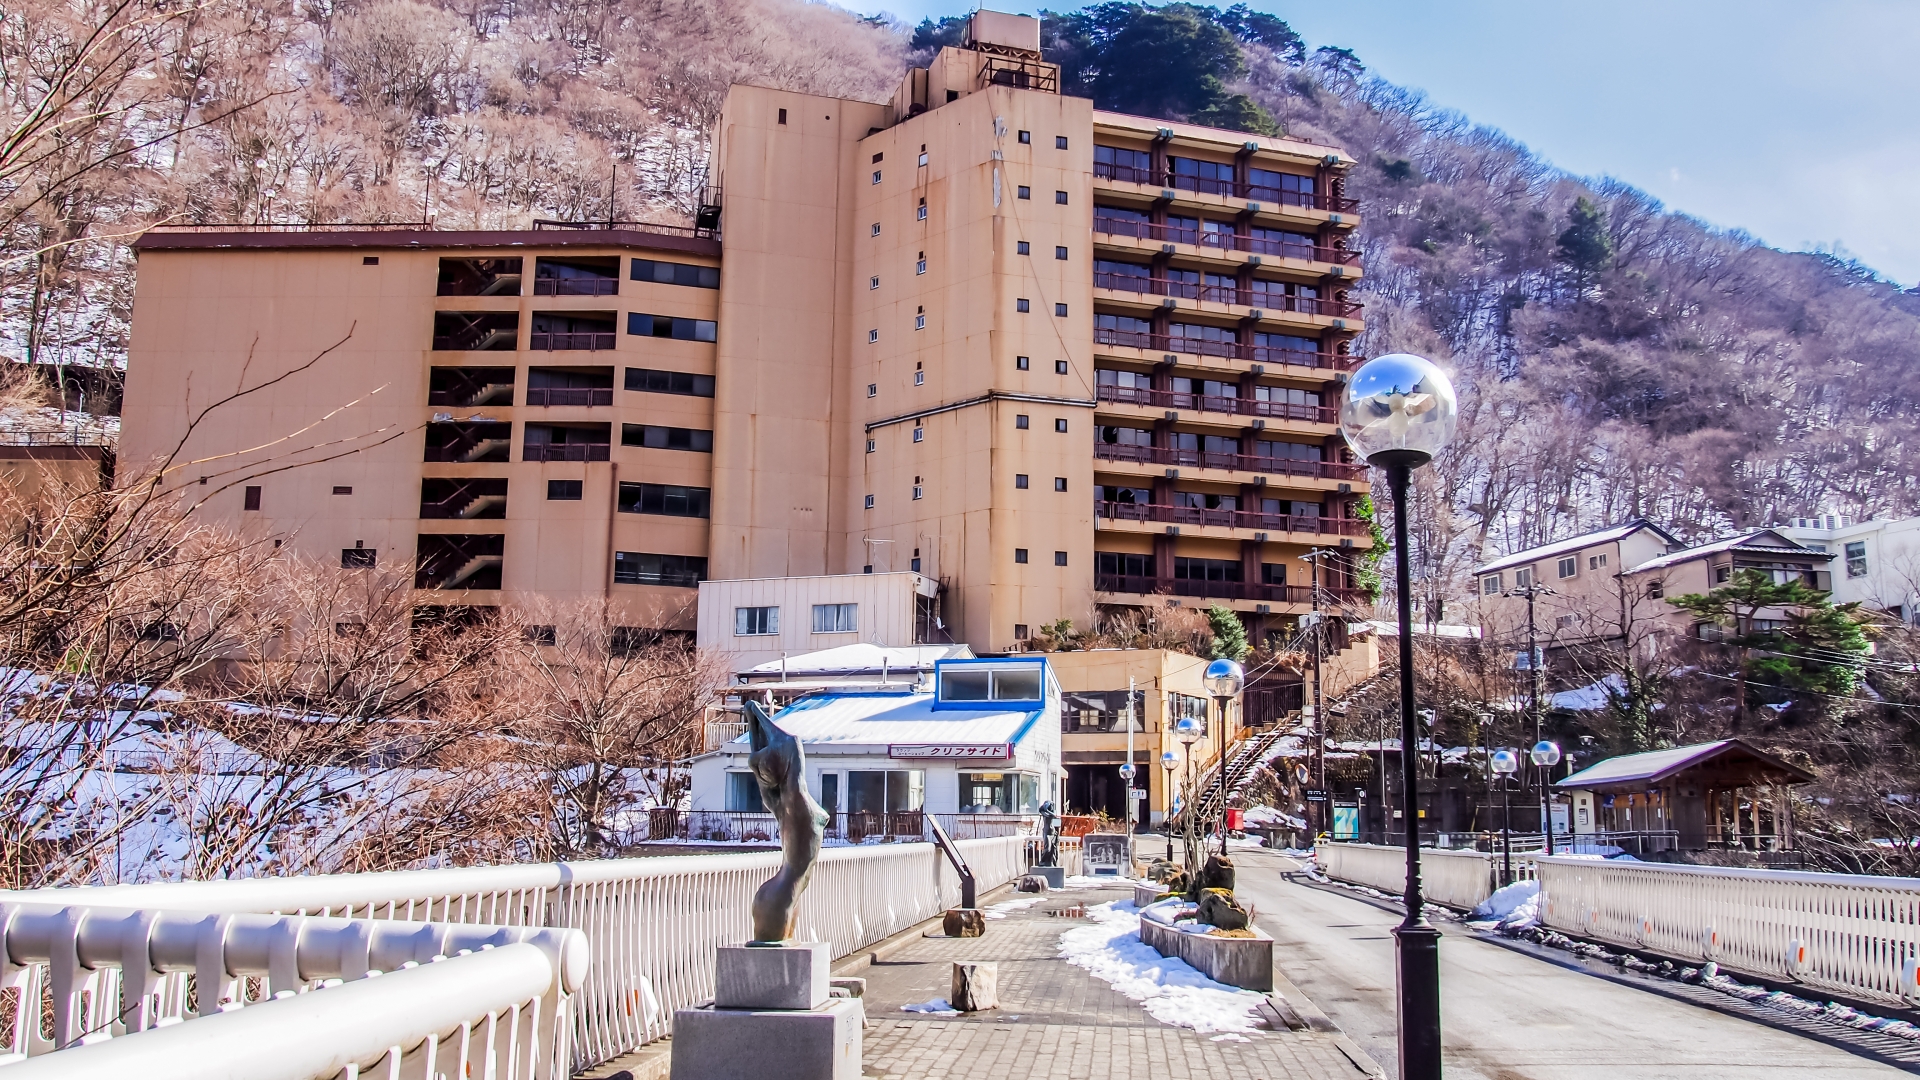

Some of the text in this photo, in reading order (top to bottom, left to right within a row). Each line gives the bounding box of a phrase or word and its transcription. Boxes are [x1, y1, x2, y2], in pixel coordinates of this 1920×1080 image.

[930, 747, 1002, 756] クリフサイド
